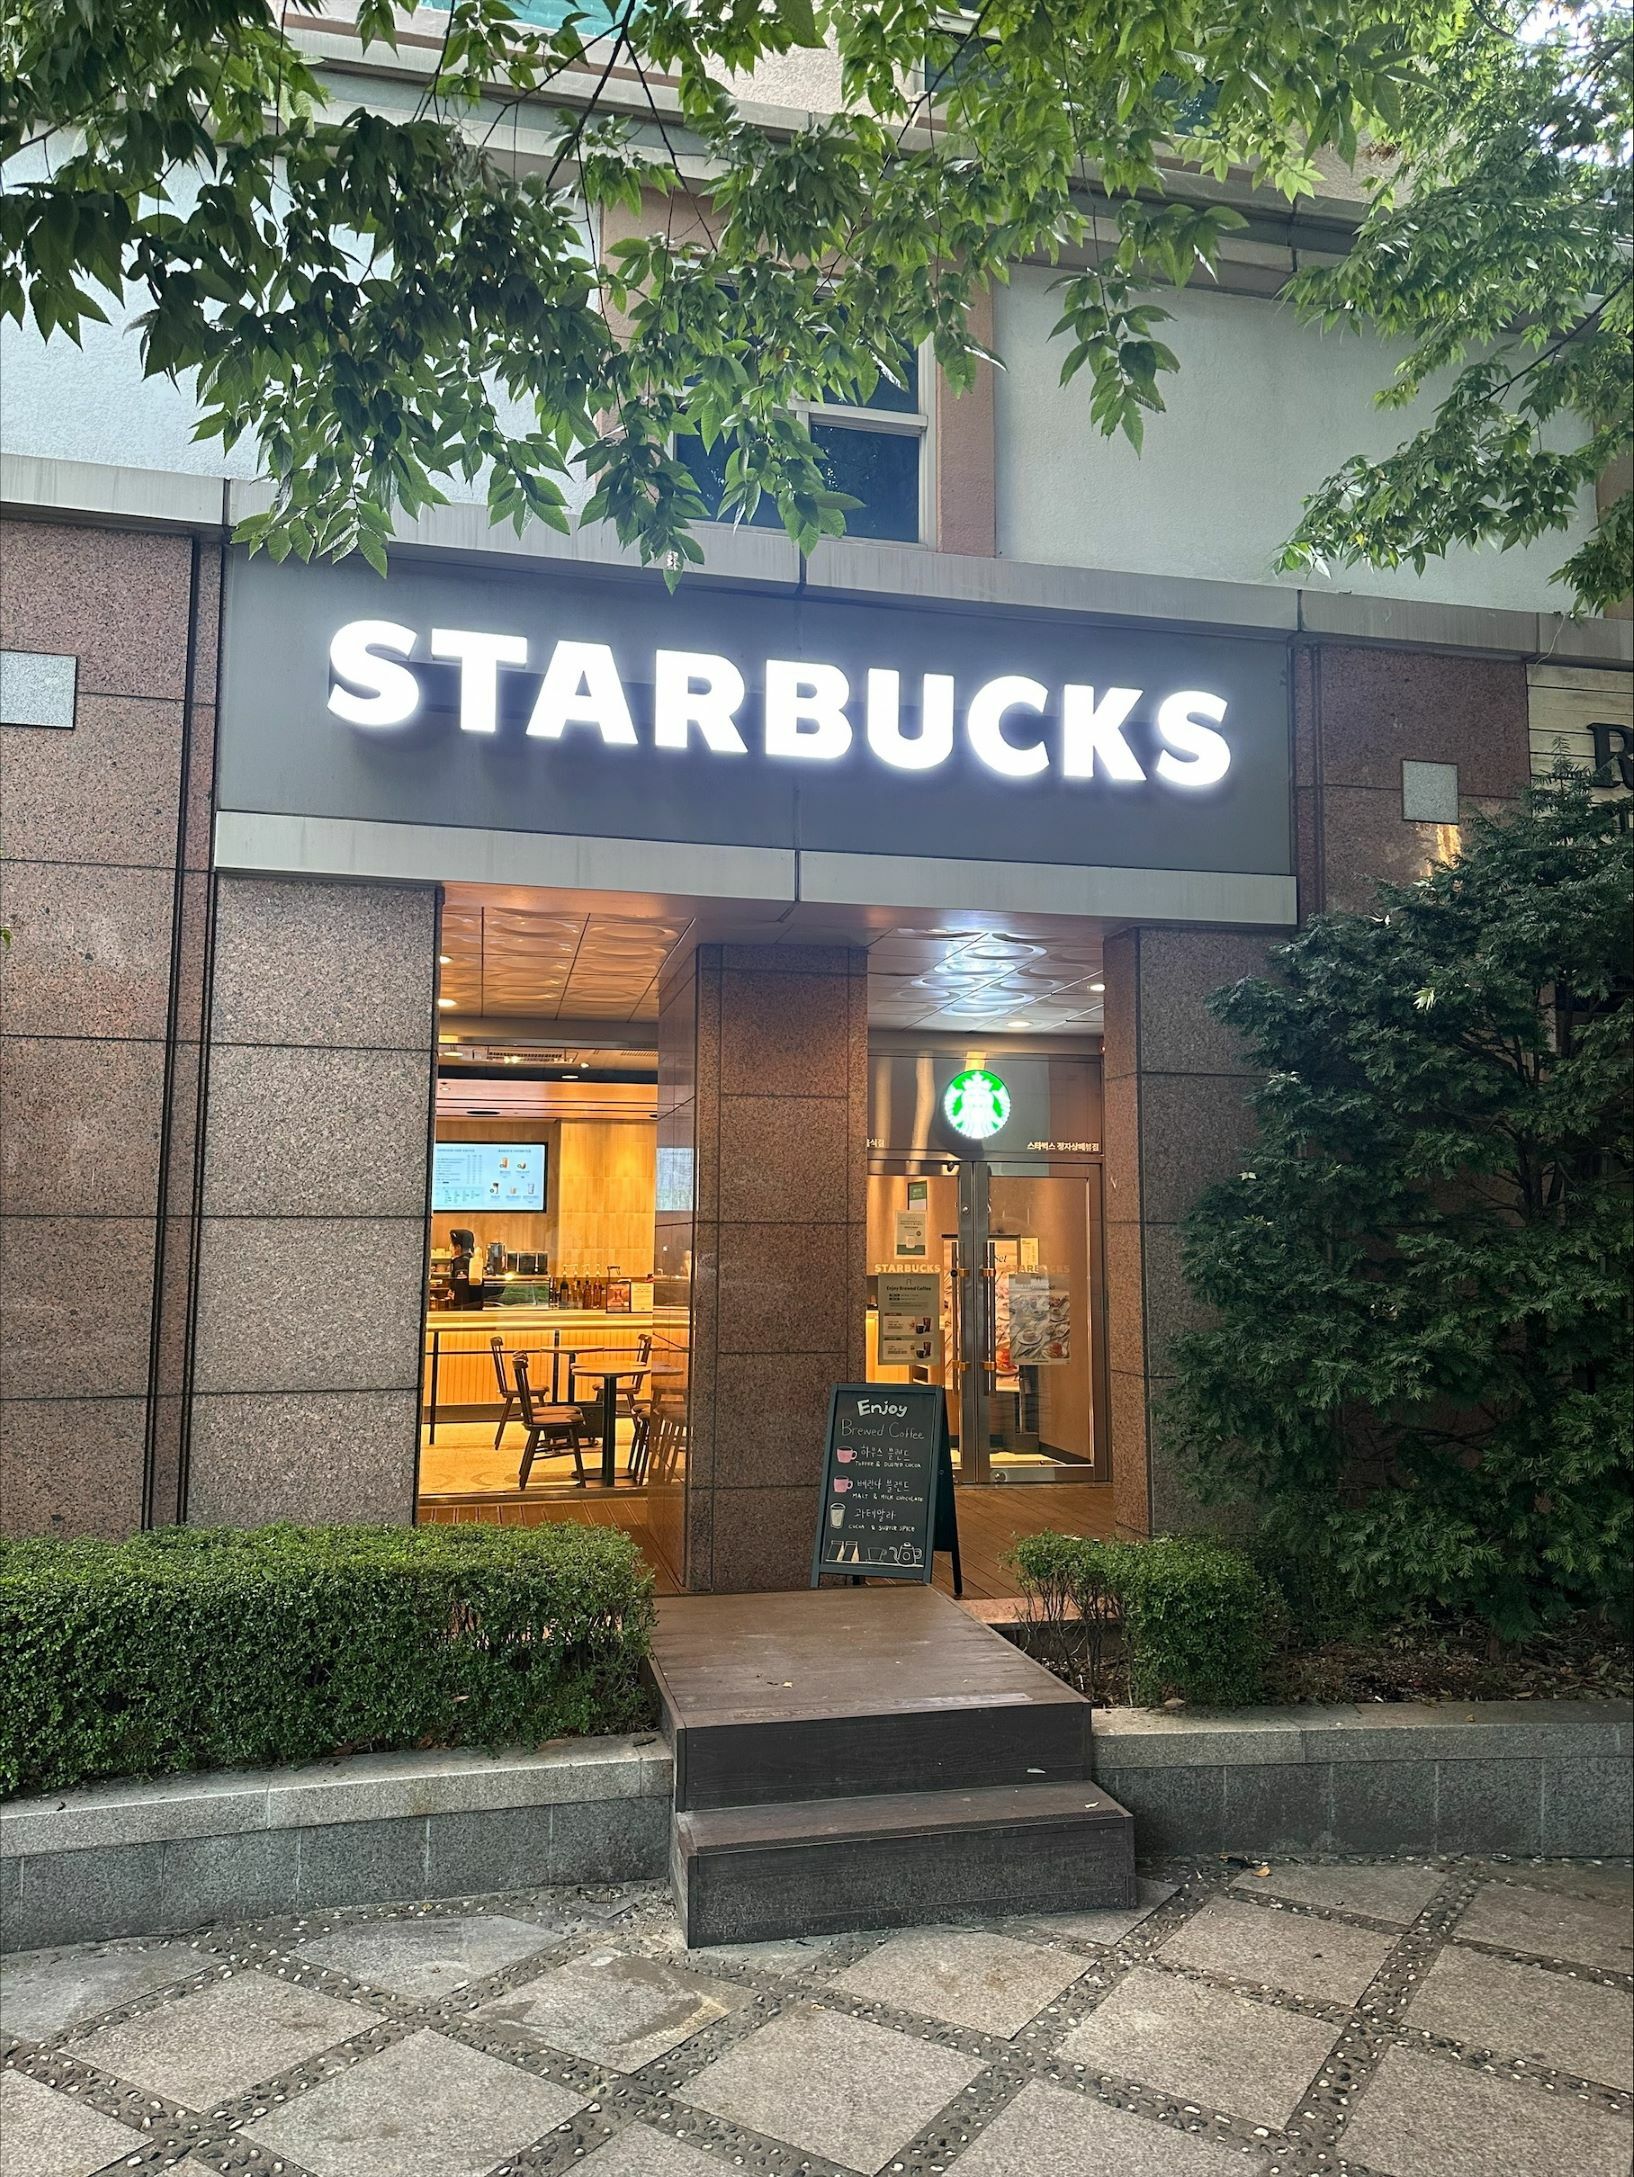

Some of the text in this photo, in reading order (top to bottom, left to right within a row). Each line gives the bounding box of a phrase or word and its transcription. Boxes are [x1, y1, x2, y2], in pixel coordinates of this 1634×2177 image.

[327, 619, 1232, 789] STARBUCKS
[1027, 1141, 1056, 1150] 스타벅스
[874, 1263, 941, 1273] STARBUCKS
[857, 1399, 908, 1418] Enjoy
[841, 1418, 925, 1440] Brewed Coffee
